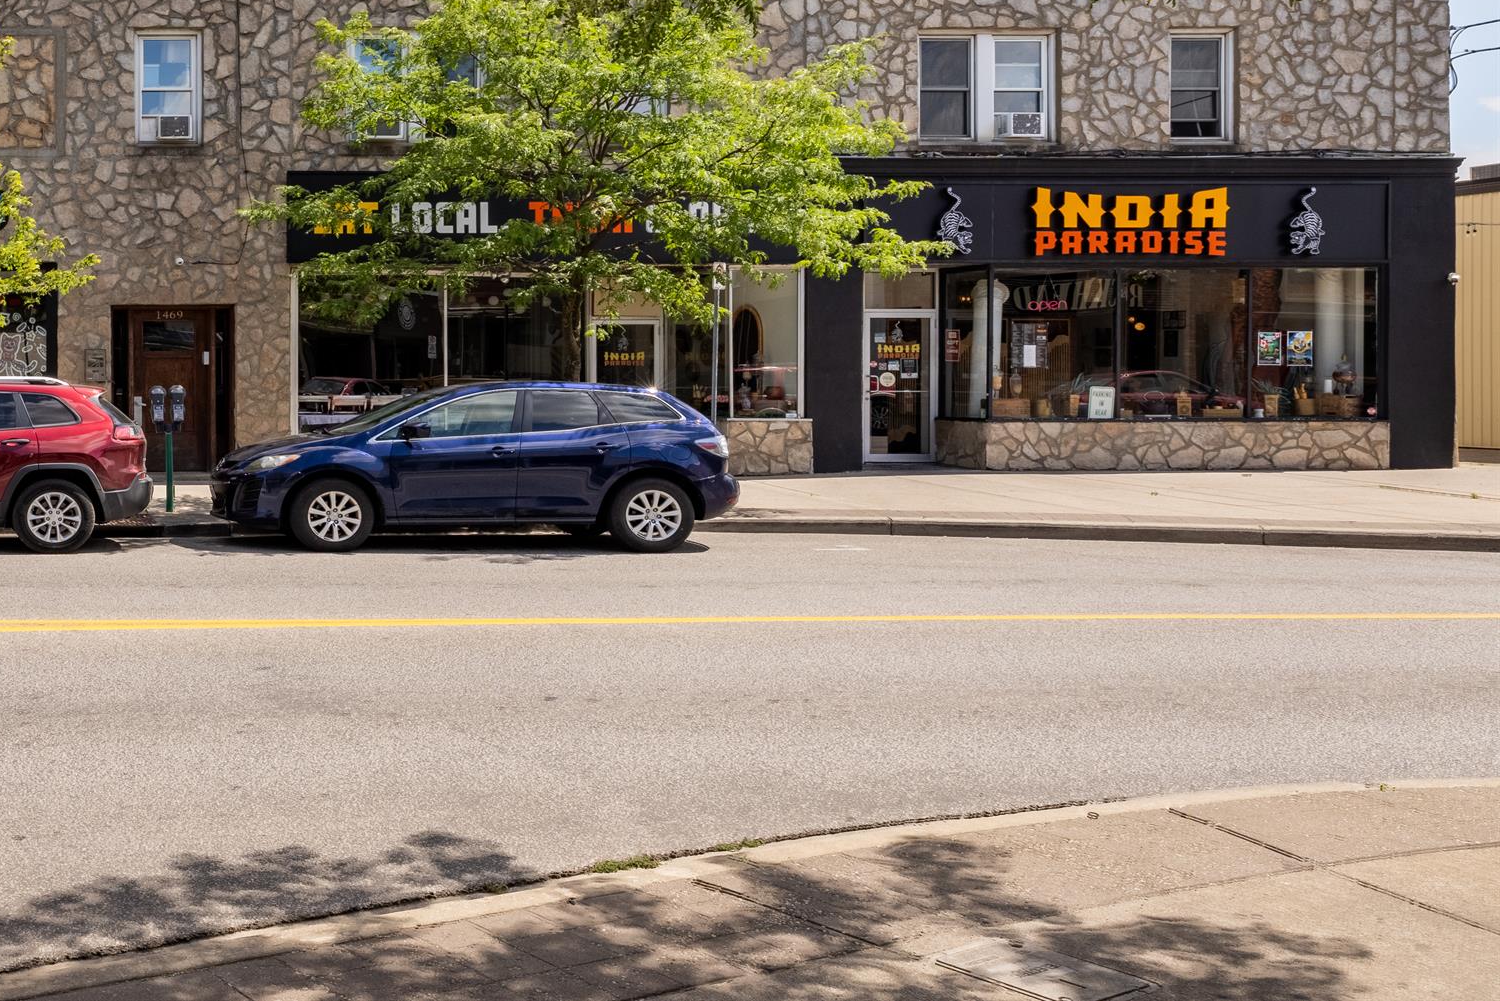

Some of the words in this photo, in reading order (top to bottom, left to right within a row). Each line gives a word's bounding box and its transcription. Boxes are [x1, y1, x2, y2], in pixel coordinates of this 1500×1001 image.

[1031, 186, 1231, 229] INDIA
[1034, 230, 1227, 256] PARADISE
[1027, 300, 1068, 312] open
[156, 310, 183, 320] 1469
[877, 343, 920, 354] INDIA
[604, 351, 645, 361] INDIA
